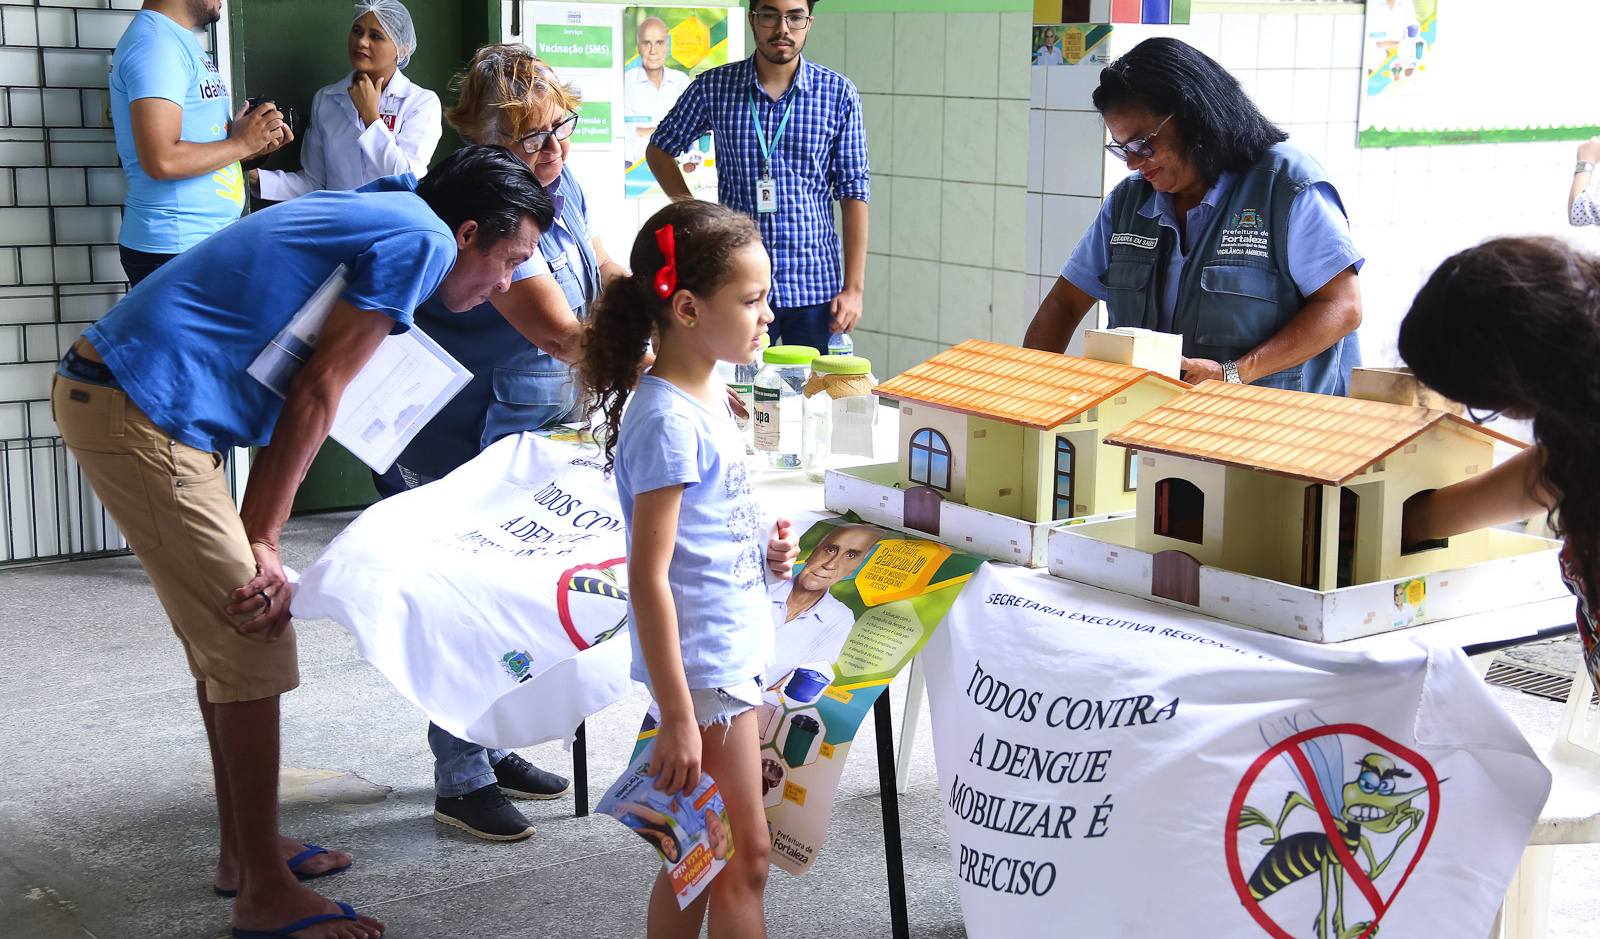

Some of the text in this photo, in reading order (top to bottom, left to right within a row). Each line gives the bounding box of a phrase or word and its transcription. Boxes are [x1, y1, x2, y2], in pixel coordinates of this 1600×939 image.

[539, 42, 609, 56] Vacinação (SMS)
[1217, 247, 1244, 255] VIGILÂNCIA
[1222, 235, 1268, 244] Fortaleza
[500, 516, 525, 531] A
[875, 548, 889, 564] 8
[891, 556, 914, 572] CADA
[908, 556, 927, 574] 10
[985, 593, 1065, 617] SECRETARIA
[1068, 612, 1156, 634] EXECUTIVA
[966, 660, 1180, 730] TODOS CONTRA
[969, 732, 1112, 784] A DENGUE
[615, 775, 640, 797] Fortaleza
[626, 779, 644, 795] Prefeitura
[949, 774, 1113, 839] MOBILIZAR É
[774, 838, 808, 864] Fortaleza
[776, 830, 812, 854] Prefeitura de
[673, 846, 702, 879] CASA NÃO
[683, 850, 712, 882] NA MINHA
[958, 844, 1057, 897] PRECISO
